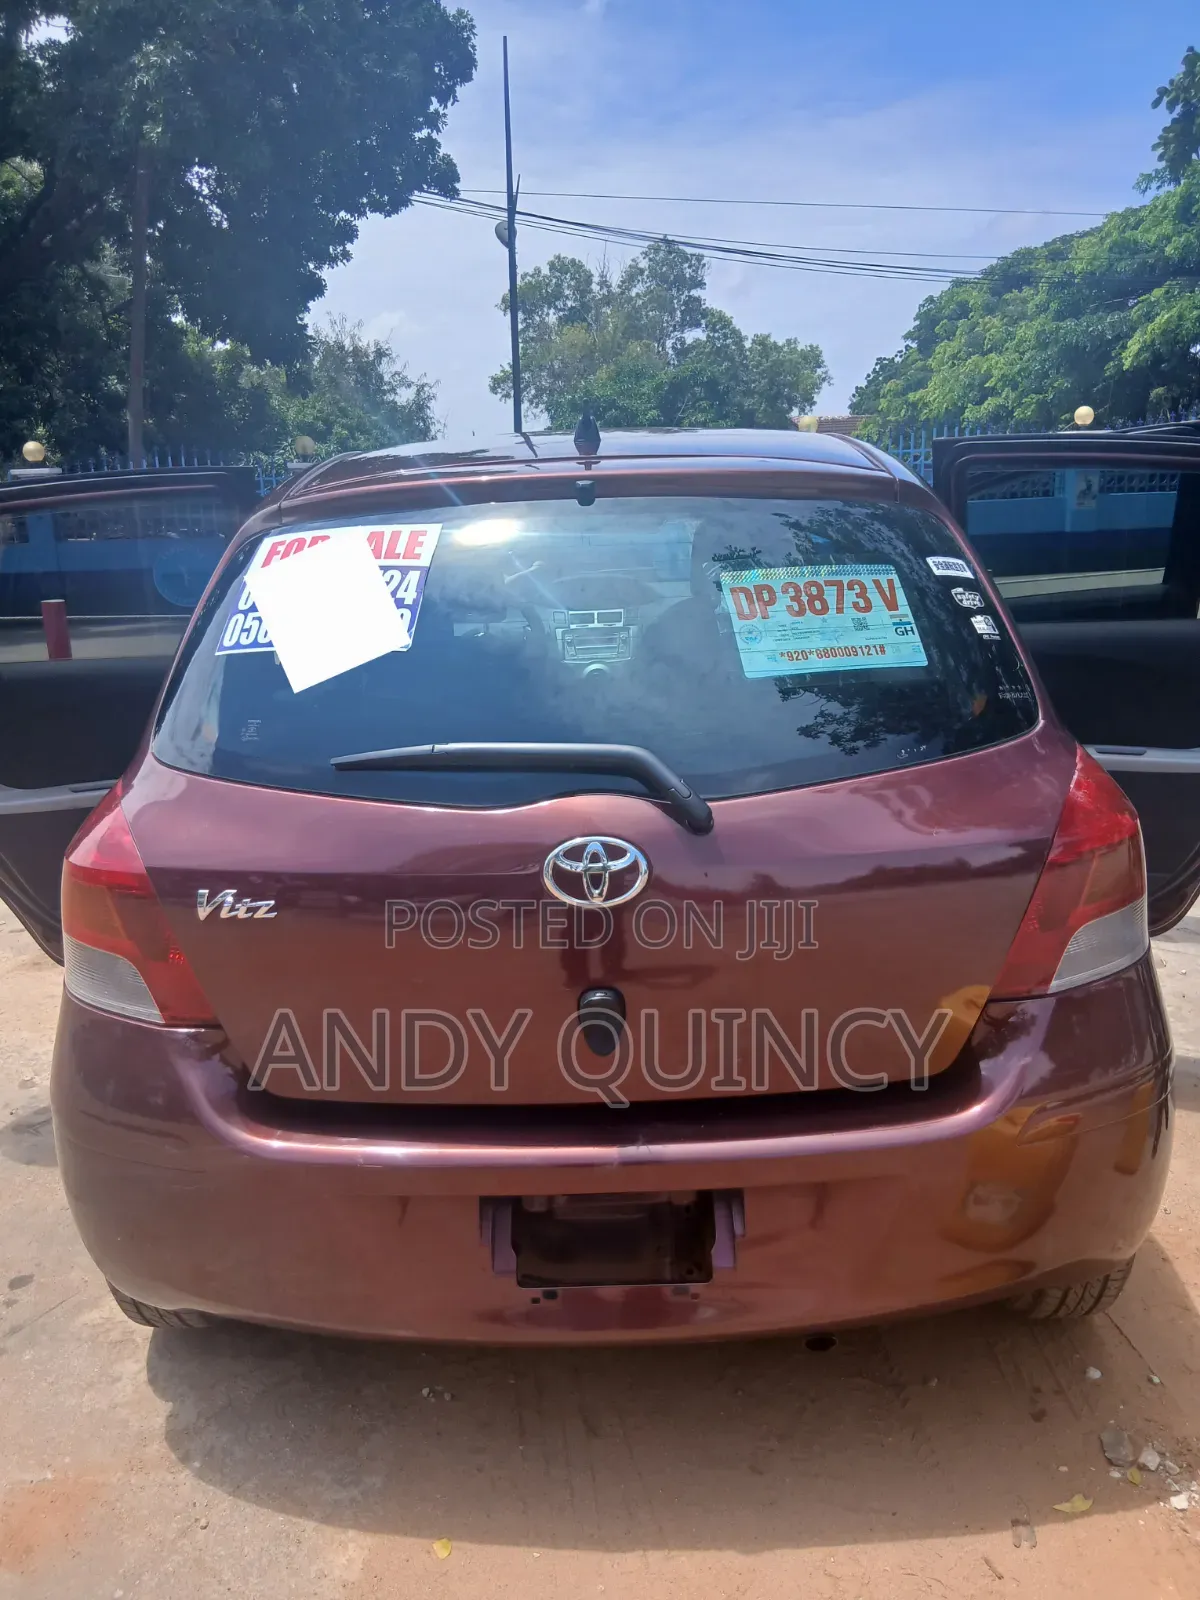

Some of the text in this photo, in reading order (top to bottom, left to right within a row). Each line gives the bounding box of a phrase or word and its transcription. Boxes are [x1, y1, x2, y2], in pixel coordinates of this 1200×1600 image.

[729, 578, 900, 621] DP 3873 V
[894, 626, 916, 637] GH
[197, 889, 278, 921] Vitz
